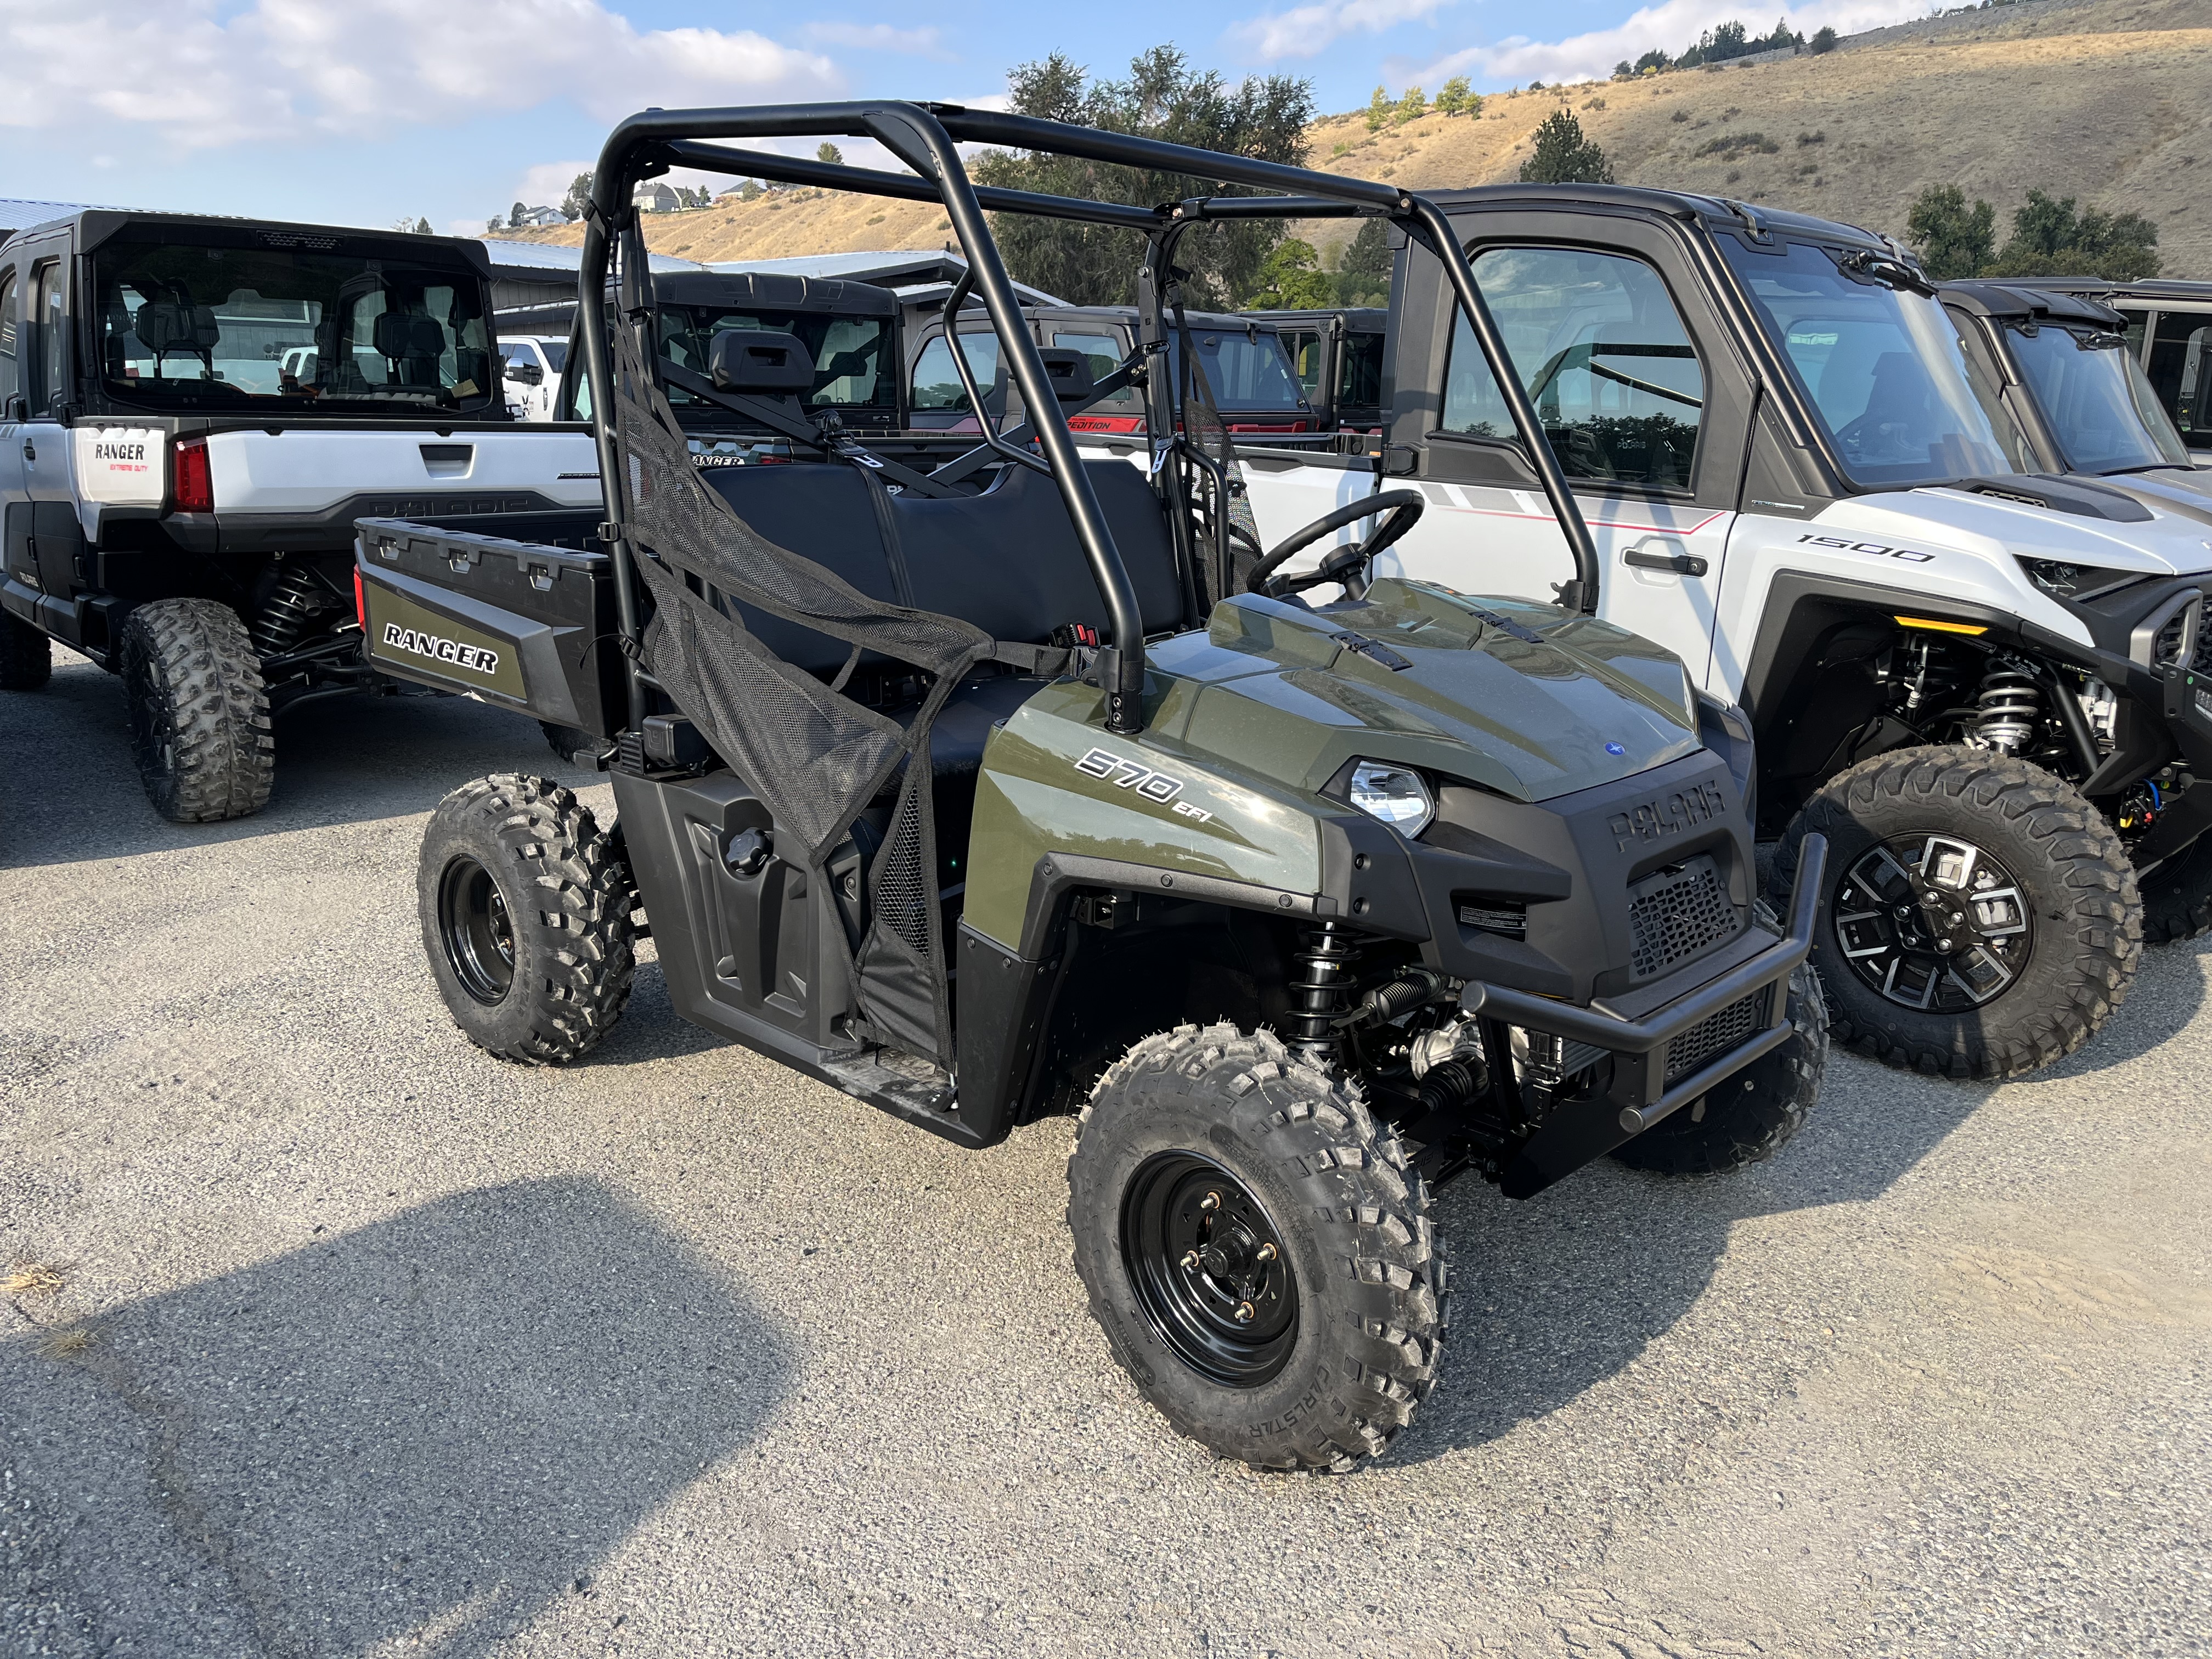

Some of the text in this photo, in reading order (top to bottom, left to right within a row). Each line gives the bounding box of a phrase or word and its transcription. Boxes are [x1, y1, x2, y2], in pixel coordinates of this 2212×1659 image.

[95, 444, 144, 460] RANGER
[692, 455, 744, 466] ANGER
[1796, 534, 1936, 563] 1500
[383, 623, 499, 674] RANGER
[1073, 747, 1214, 823] 570 EFI
[1606, 780, 1726, 854] POLARIS
[1248, 1364, 1330, 1438] CARLSTAR
